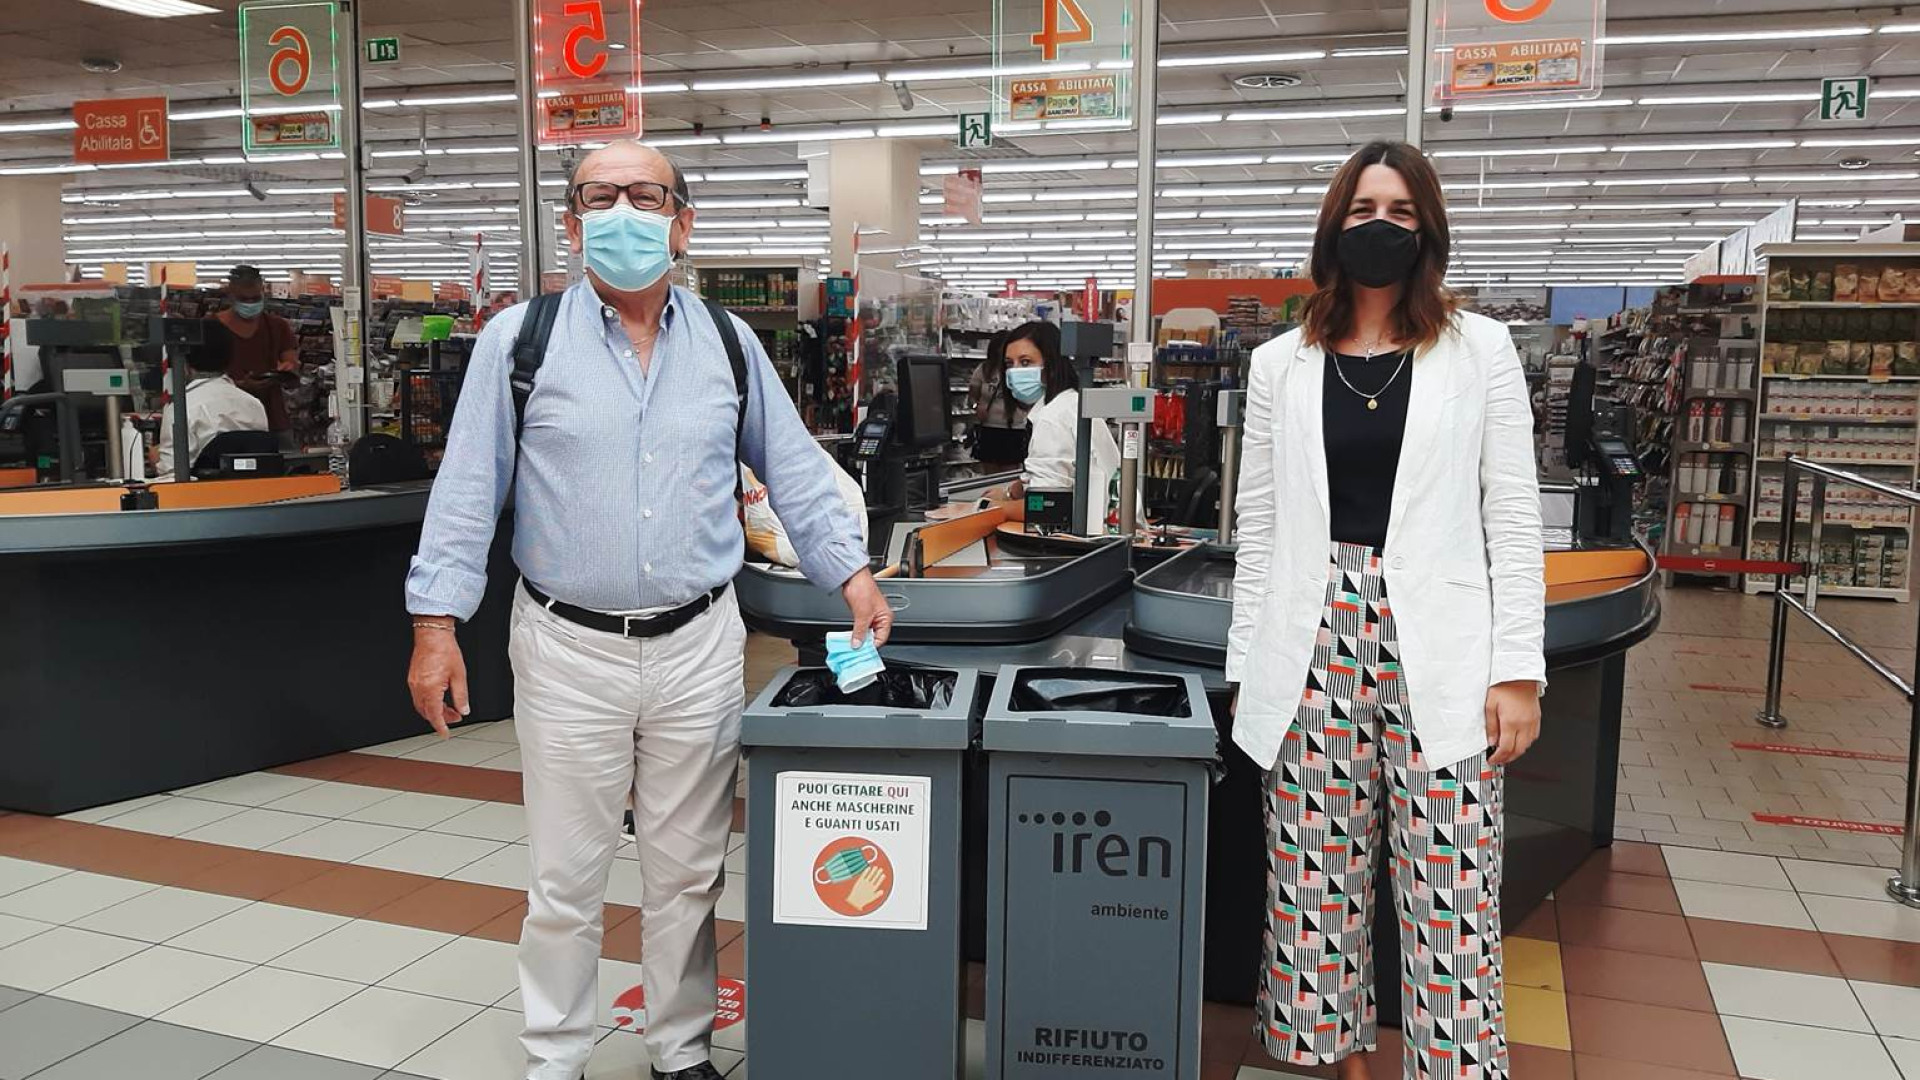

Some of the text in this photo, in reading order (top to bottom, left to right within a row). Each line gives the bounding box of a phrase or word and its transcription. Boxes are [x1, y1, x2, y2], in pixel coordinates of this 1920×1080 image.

[1456, 42, 1578, 59] CASSA ABILITATA
[1012, 77, 1114, 93] CASSA ABILITATA
[548, 92, 624, 107] CASSA ABILITATA
[84, 113, 127, 129] Cassa
[80, 135, 133, 151] Abilitata
[392, 205, 401, 229] 8
[797, 782, 909, 799] PUOI GETTARE QUI
[791, 800, 915, 815] ANCHE MASCHERINE
[805, 817, 900, 831] E GUANTI USATI
[1053, 832, 1171, 878] iren
[1091, 903, 1169, 920] ambiente
[1035, 1027, 1148, 1052] RIFIUTO
[1017, 1051, 1165, 1070] INDIFFERENZIATO
